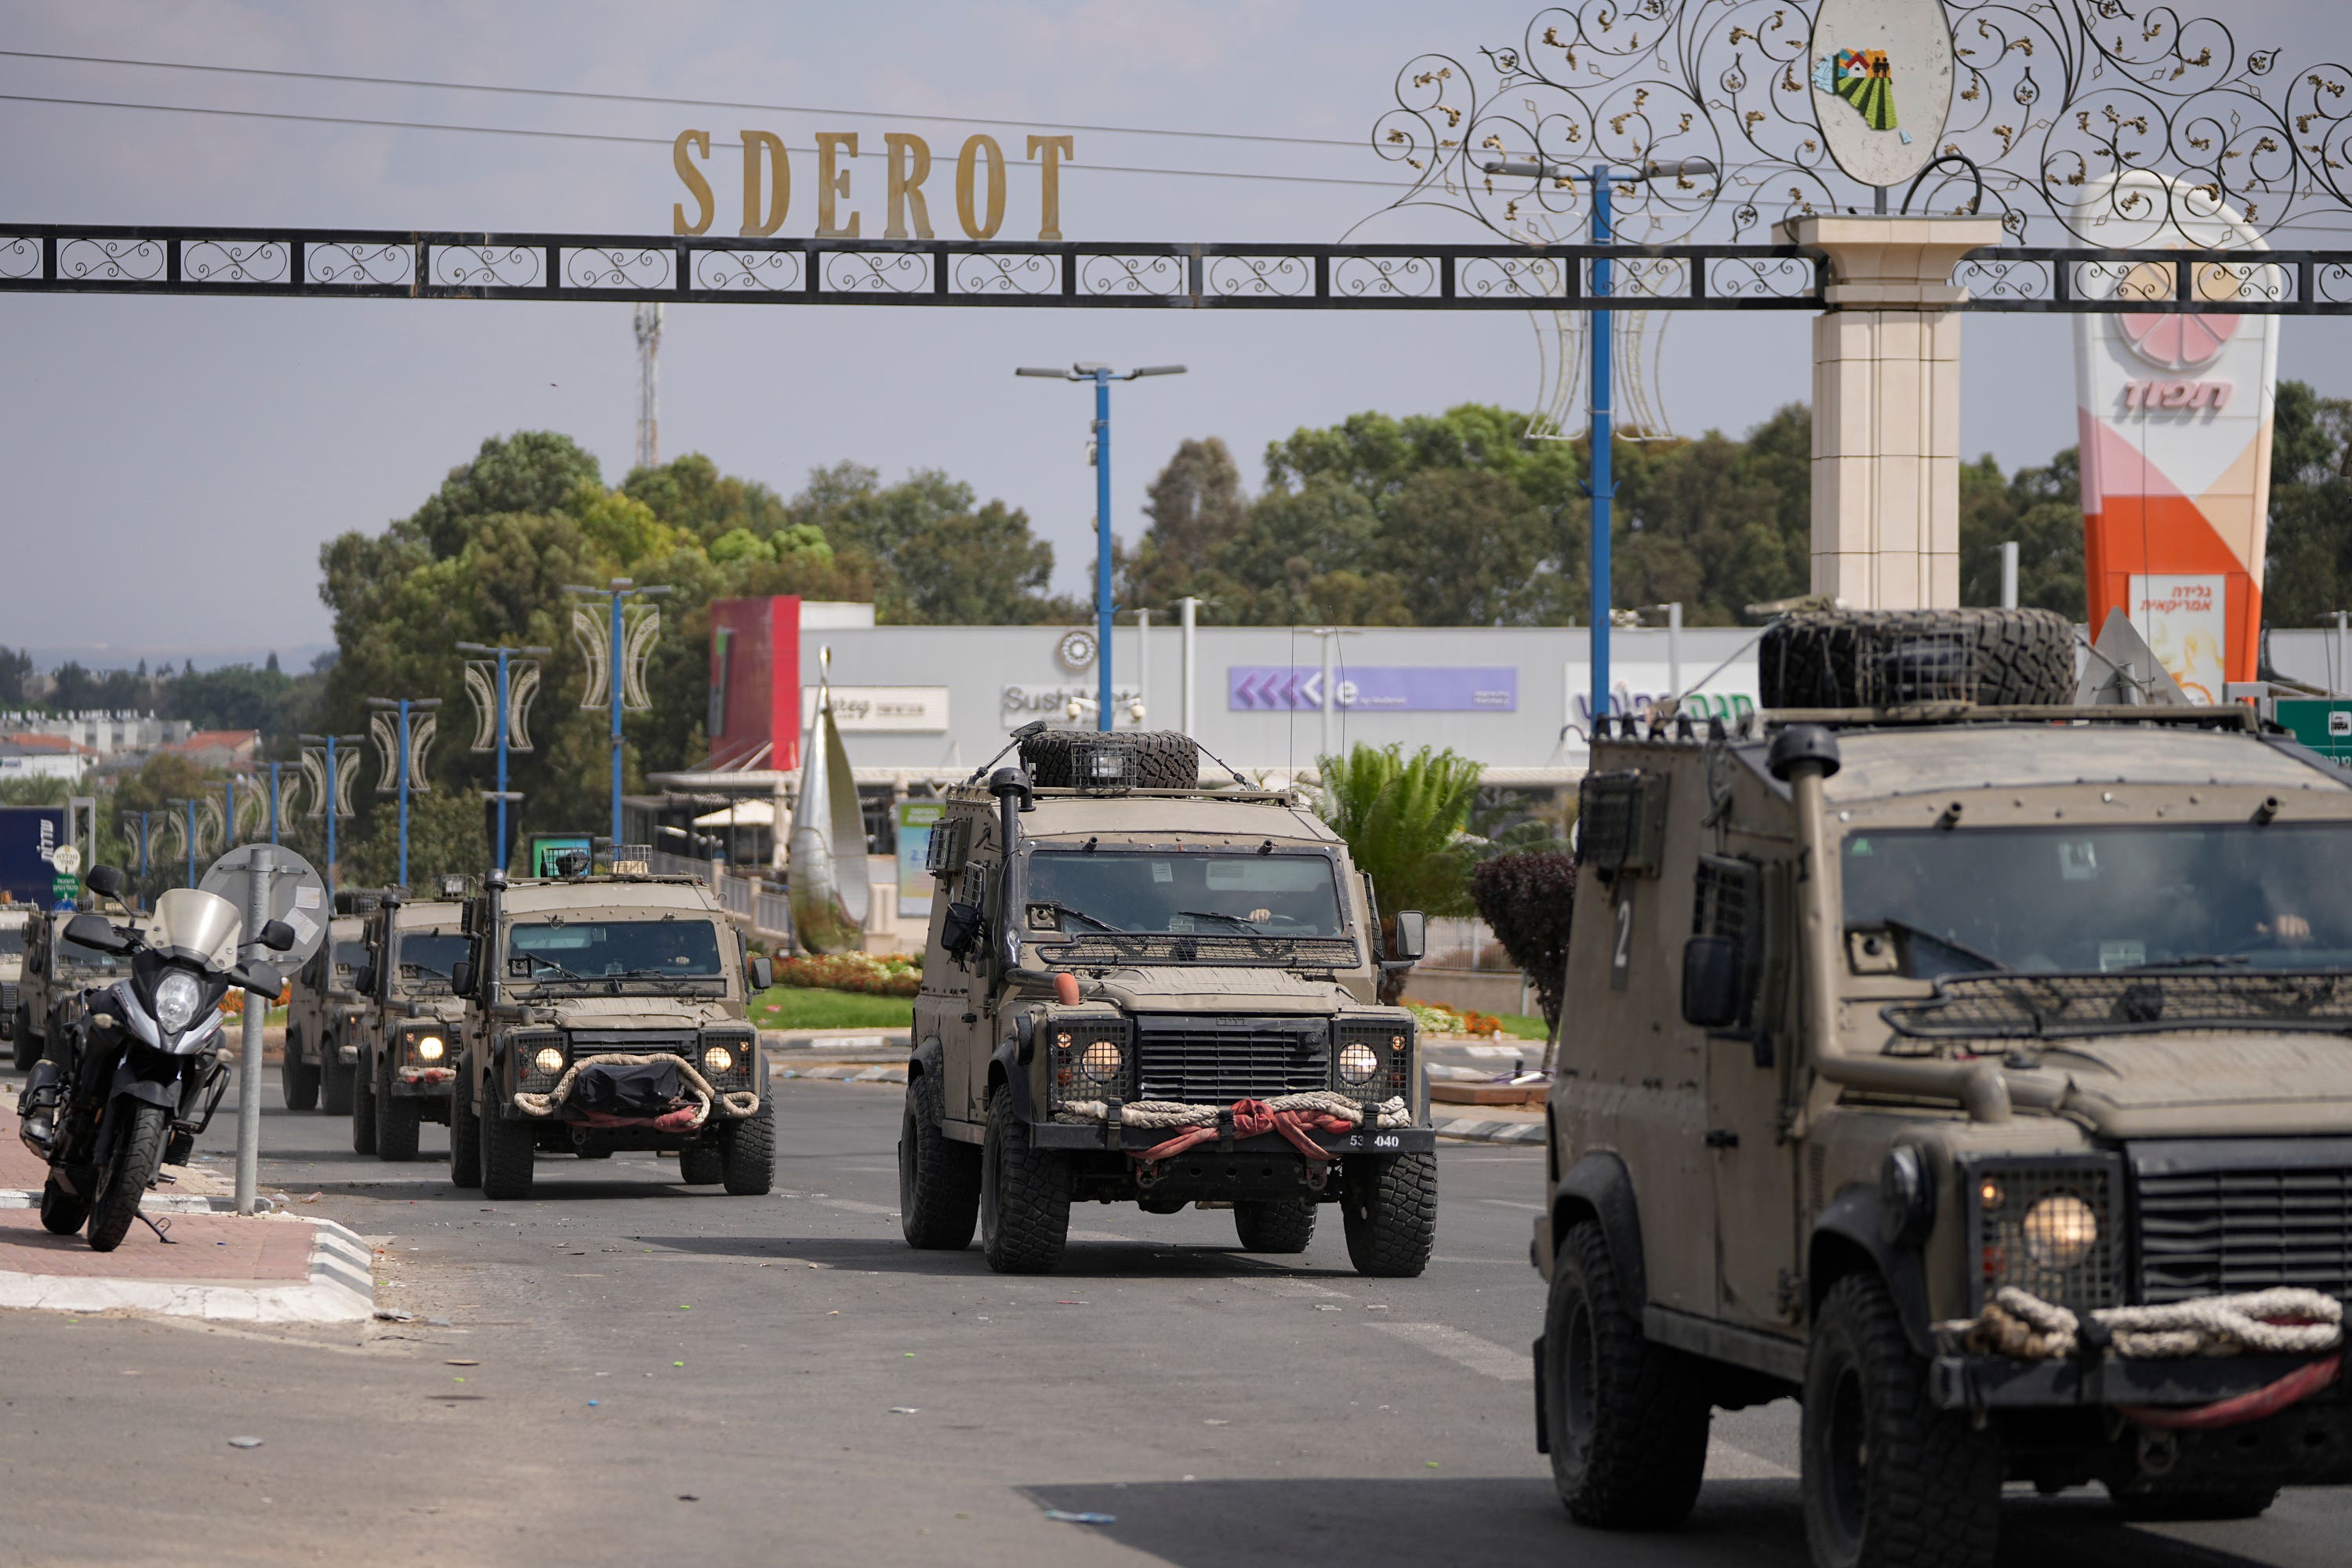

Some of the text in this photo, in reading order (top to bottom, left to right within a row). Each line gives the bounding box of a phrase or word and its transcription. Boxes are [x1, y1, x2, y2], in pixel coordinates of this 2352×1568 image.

[673, 129, 1073, 240] SDEROT
[2125, 380, 2233, 410] תפוז
[2172, 585, 2212, 597] גלידה
[2140, 599, 2212, 615] אמריקאית
